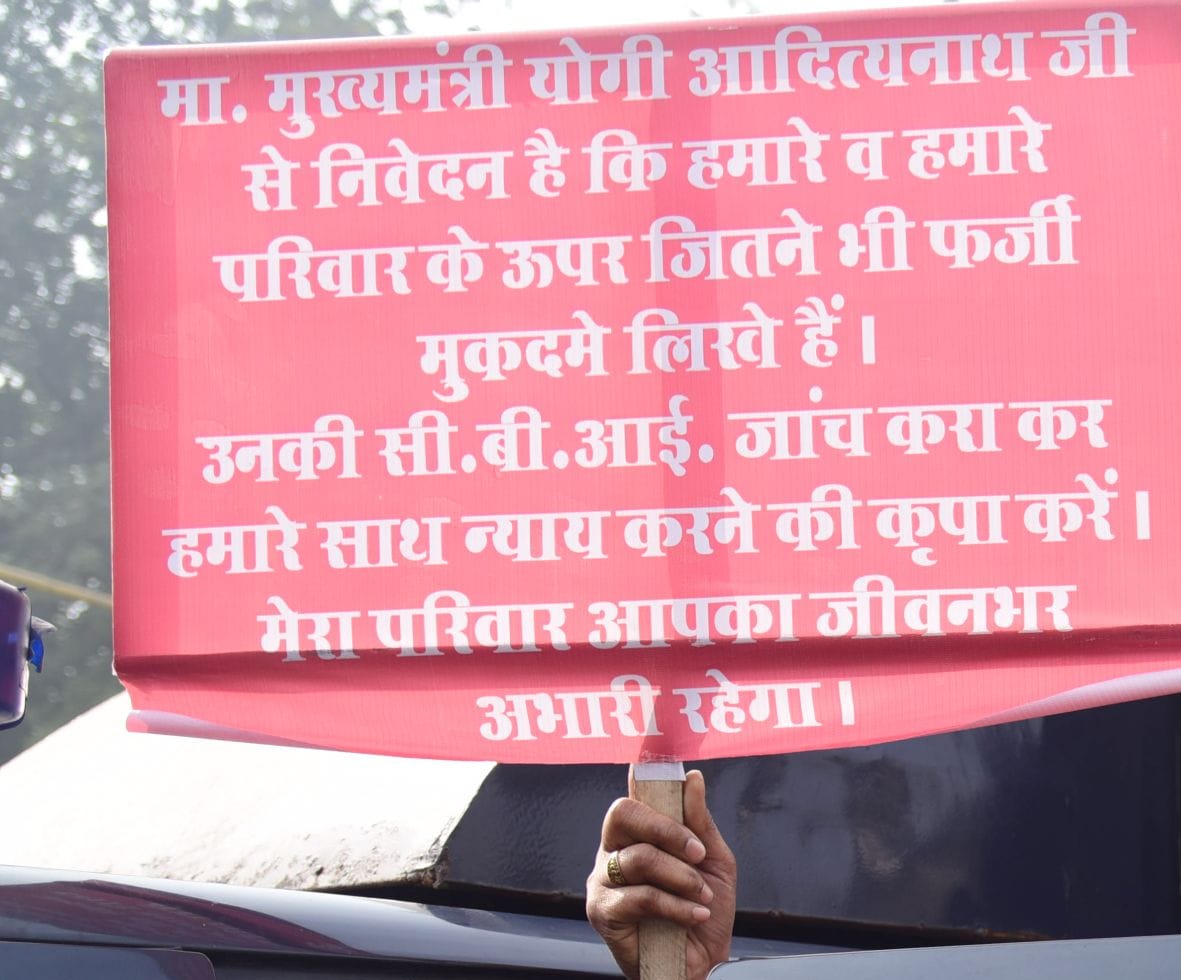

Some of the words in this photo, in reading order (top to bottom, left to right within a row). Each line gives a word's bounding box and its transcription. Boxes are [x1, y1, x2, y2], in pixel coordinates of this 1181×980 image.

[158, 77, 247, 126] मा.
[266, 40, 512, 138] मुख्यमंत्री
[525, 35, 672, 104] योगी
[689, 26, 1032, 96] आदित्यनाथ
[1042, 13, 1135, 78] जी
[242, 146, 300, 211] से
[311, 139, 513, 208] निवेदन
[525, 129, 570, 197] है
[582, 130, 672, 193] कि
[683, 117, 830, 189] हमारे
[841, 131, 893, 180] व
[902, 106, 1051, 179] हमारे
[213, 236, 415, 301] परिवार
[419, 226, 489, 292] के
[496, 236, 632, 288] ऊपर
[642, 209, 822, 282] जितने
[839, 206, 915, 272] भी
[924, 195, 1081, 268] फर्जी
[416, 311, 611, 402] मुकदमे
[623, 303, 783, 373] लिखे
[196, 415, 363, 483] उनकी
[728, 387, 872, 459] जांच
[878, 403, 1003, 454] करा
[1009, 400, 1112, 449] कर
[163, 506, 306, 577] हमारे
[317, 517, 450, 568] साथ
[461, 511, 611, 561] न्याय
[616, 487, 761, 557] करने
[767, 484, 862, 551] की
[868, 495, 1010, 566] कृपा
[257, 596, 360, 660] मेरा
[368, 591, 573, 656] परिवार
[588, 594, 801, 648] आपका
[809, 575, 1077, 637] जीवनभर
[477, 675, 663, 741] अभारी
